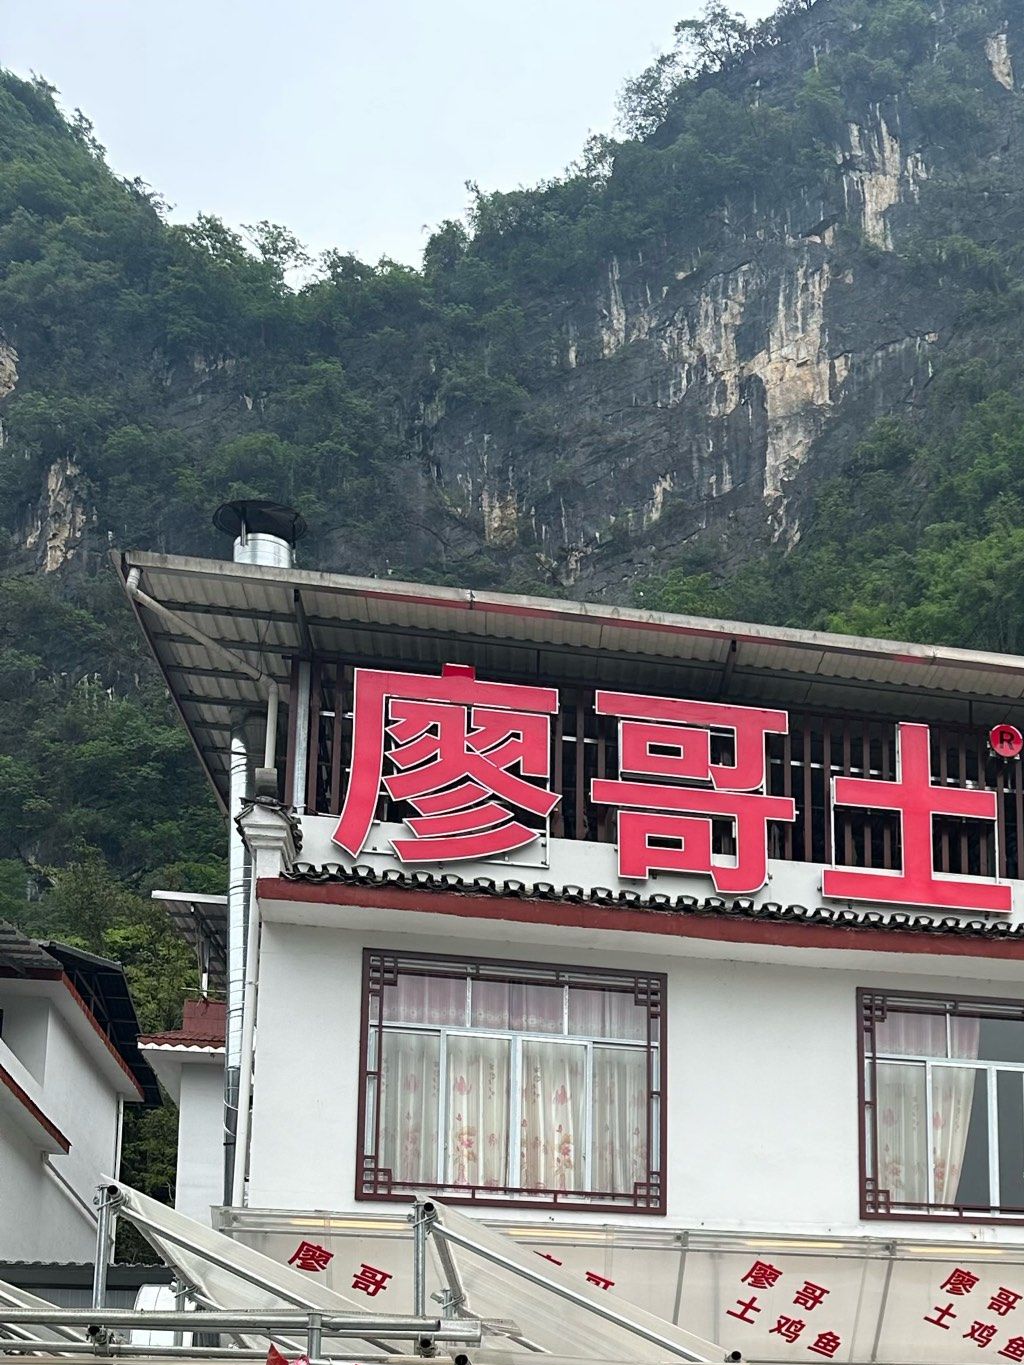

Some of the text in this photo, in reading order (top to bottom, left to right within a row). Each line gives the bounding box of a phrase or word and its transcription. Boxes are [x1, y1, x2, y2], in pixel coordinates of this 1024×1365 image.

[290, 1240, 391, 1297] 廖哥
[742, 1260, 829, 1311] 廖哥
[942, 1268, 1022, 1317] 廖哥
[727, 1296, 841, 1359] 土鸡鱼
